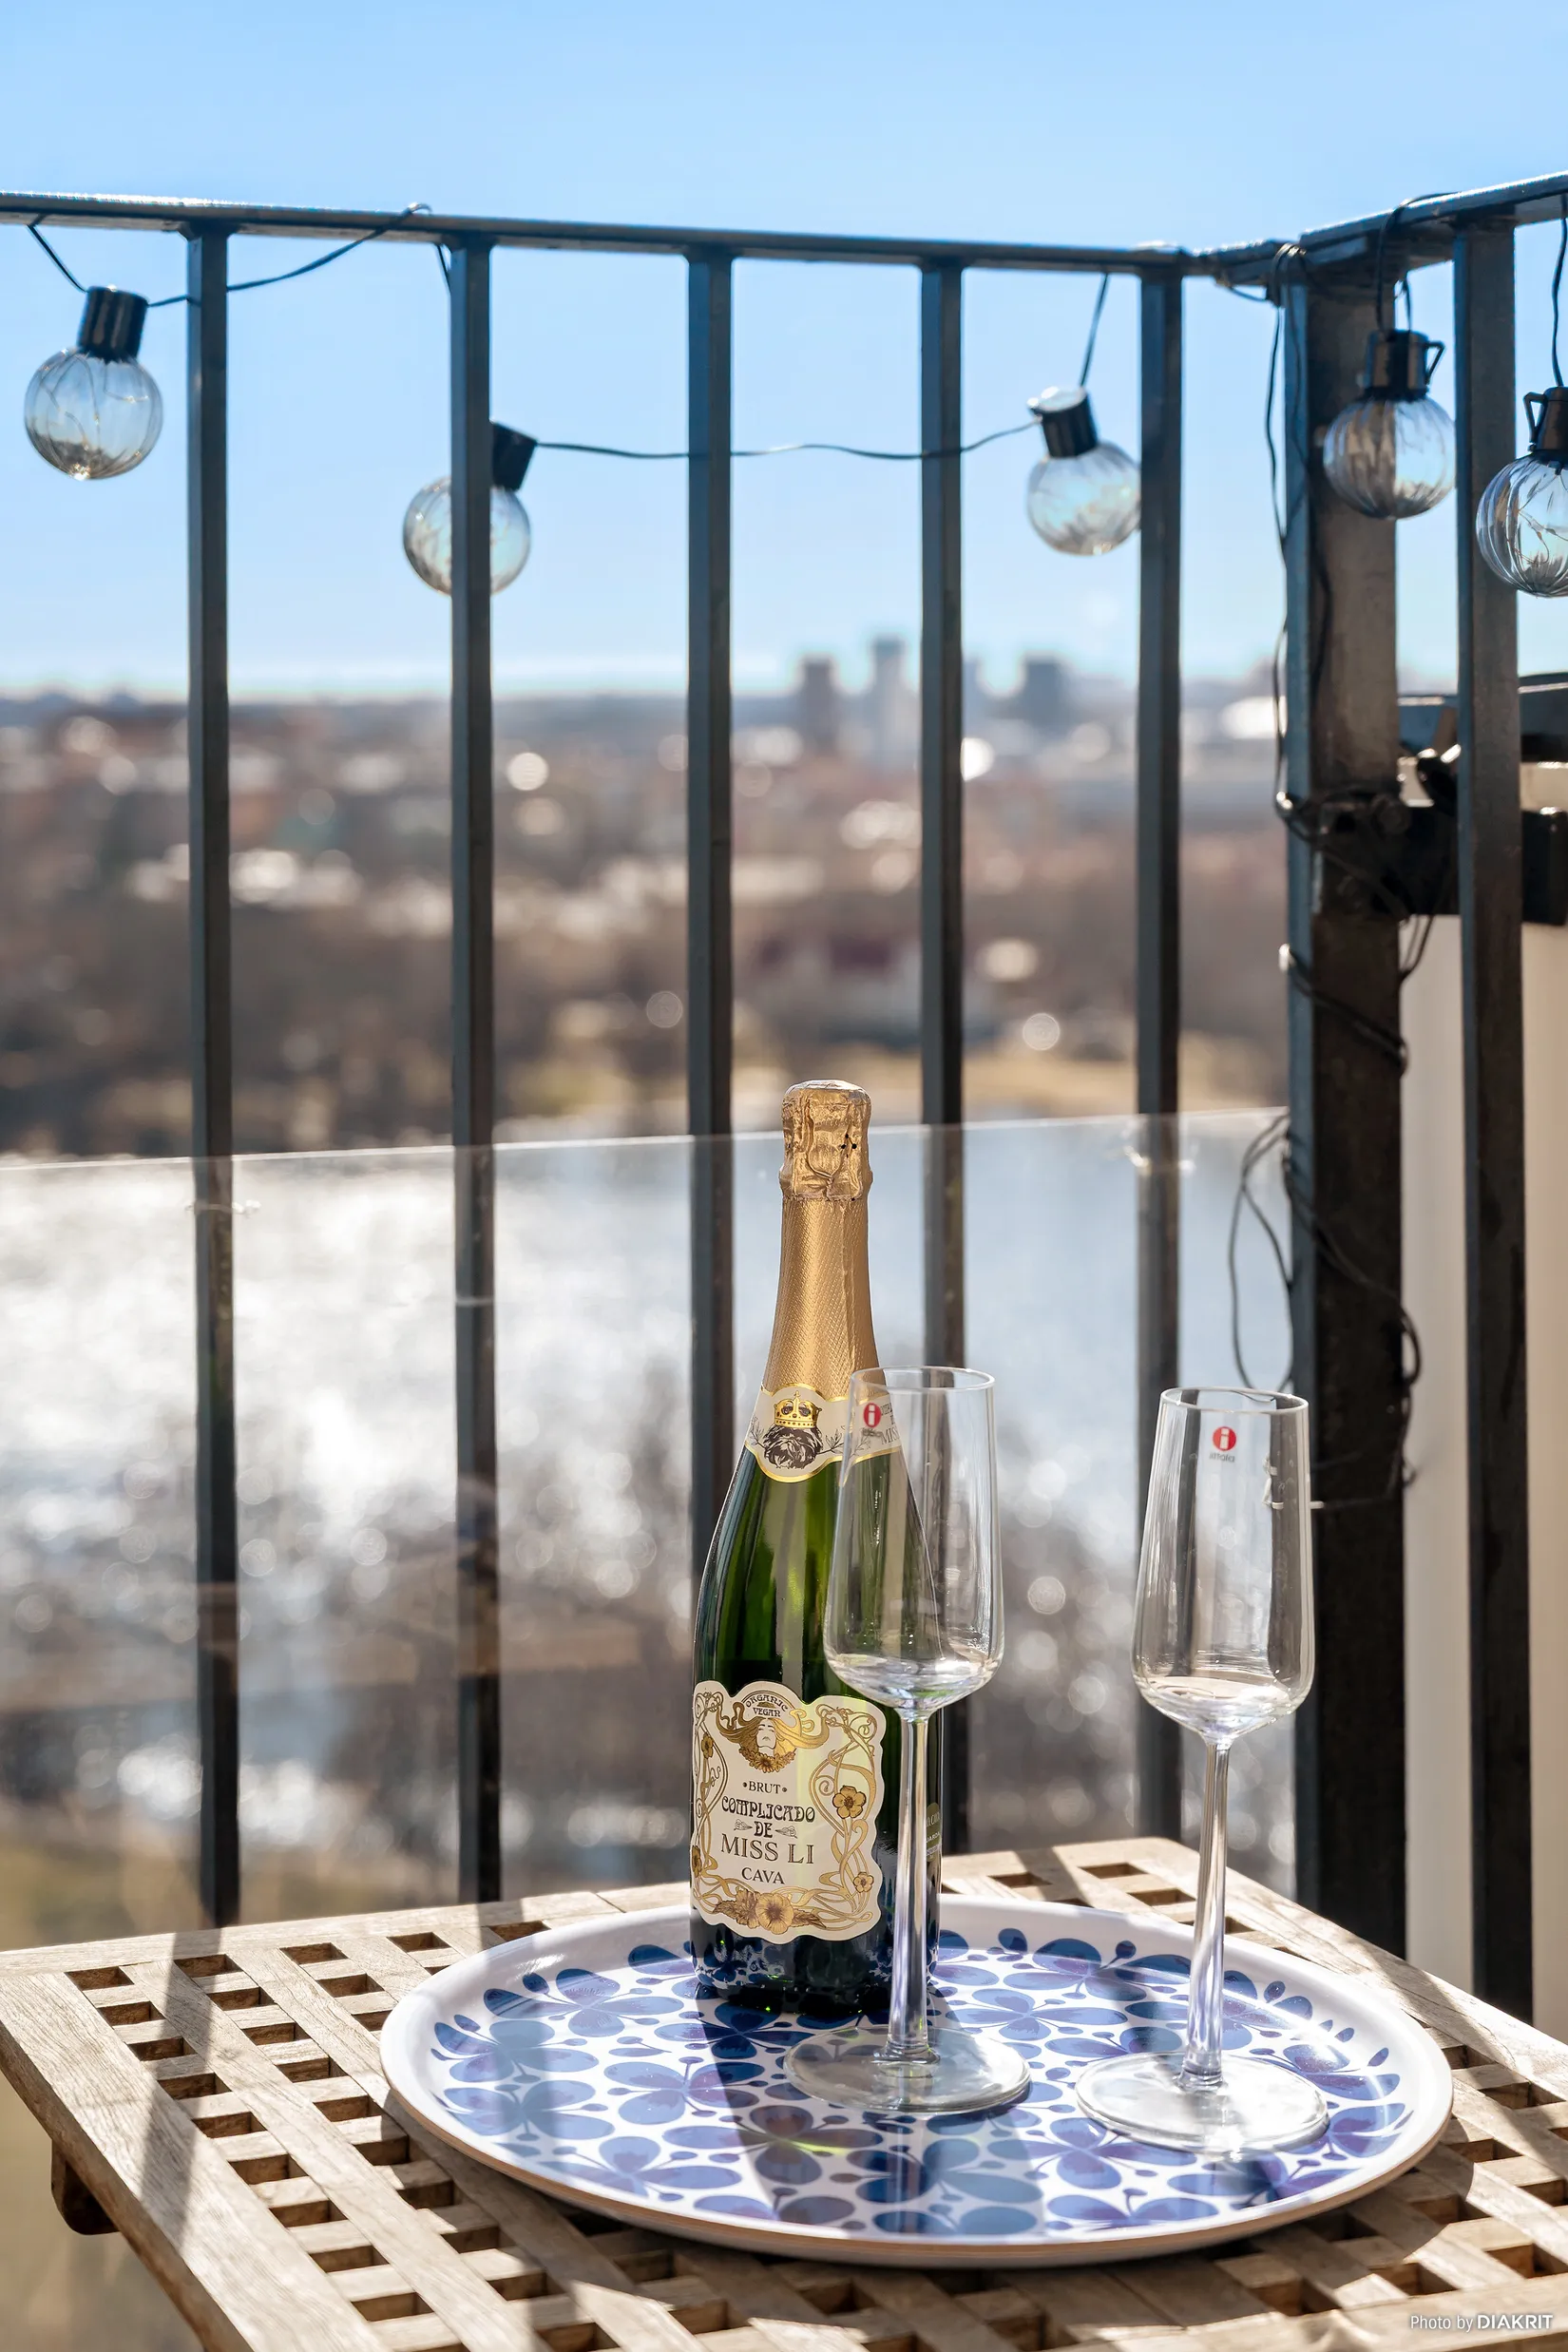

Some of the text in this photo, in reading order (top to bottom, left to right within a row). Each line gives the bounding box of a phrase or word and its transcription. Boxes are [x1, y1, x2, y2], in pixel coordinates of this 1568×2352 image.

[745, 1693, 789, 1712] ORGANIC
[753, 1707, 781, 1717] VEGAN
[721, 1796, 815, 1823] COMPLICADO
[754, 1822, 774, 1838] DE
[720, 1833, 814, 1864] MISS LI
[741, 1867, 785, 1884] CAVA
